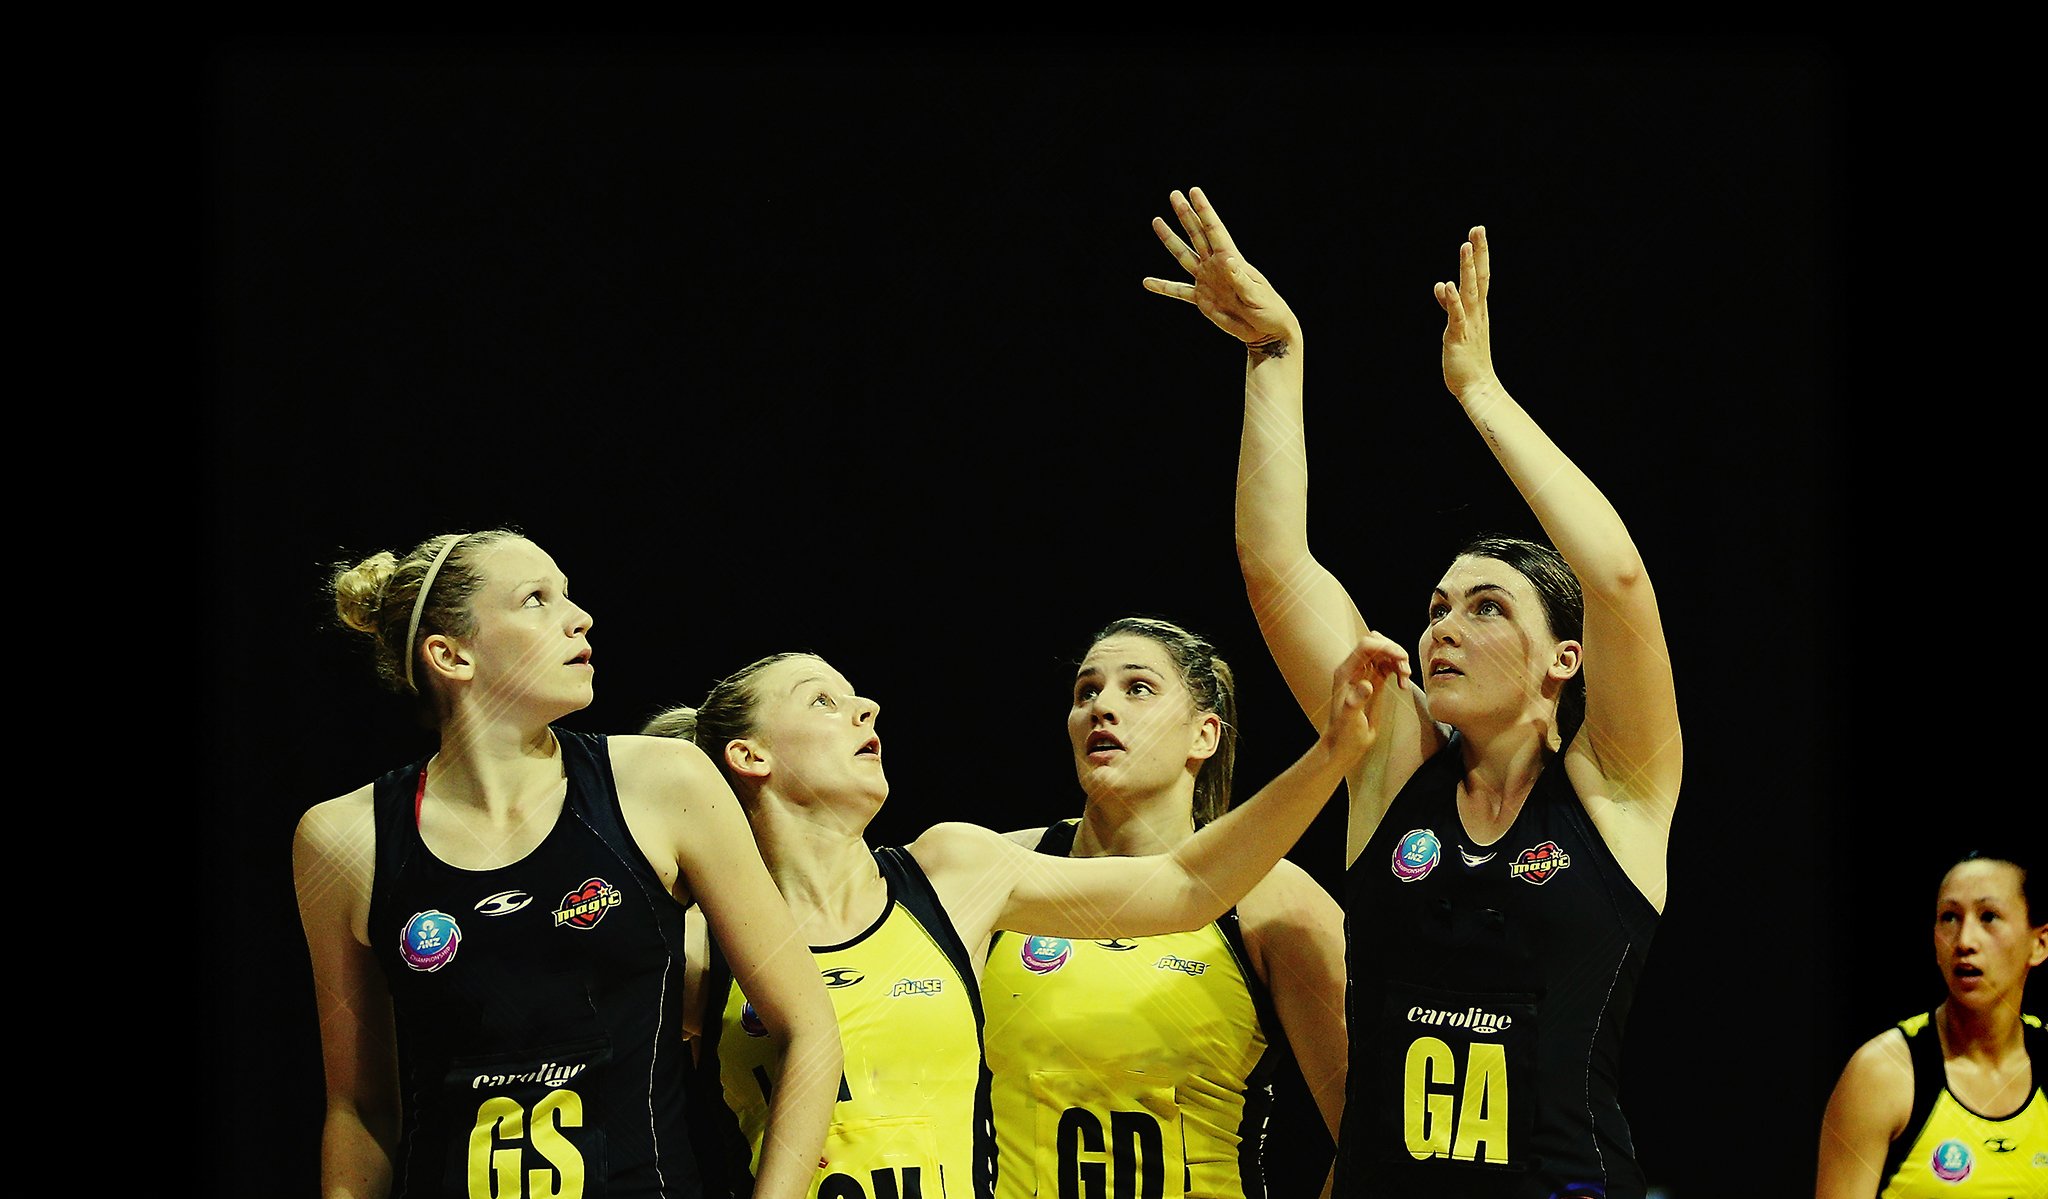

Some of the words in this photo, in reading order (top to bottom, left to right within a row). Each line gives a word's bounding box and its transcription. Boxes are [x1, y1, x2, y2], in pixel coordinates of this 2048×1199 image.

[1404, 852, 1424, 862] ANZ
[1513, 857, 1568, 874] magic
[557, 892, 619, 923] magic
[417, 937, 441, 950] ANZ
[410, 946, 451, 963] CHAMPIONSHIP
[1158, 957, 1206, 975] PULSE
[893, 979, 941, 997] PULSE
[1407, 1006, 1512, 1030] caroline
[472, 1062, 586, 1089] caroline
[1403, 1036, 1509, 1165] GA
[467, 1088, 585, 1199] GS
[1056, 1106, 1165, 1199] GD
